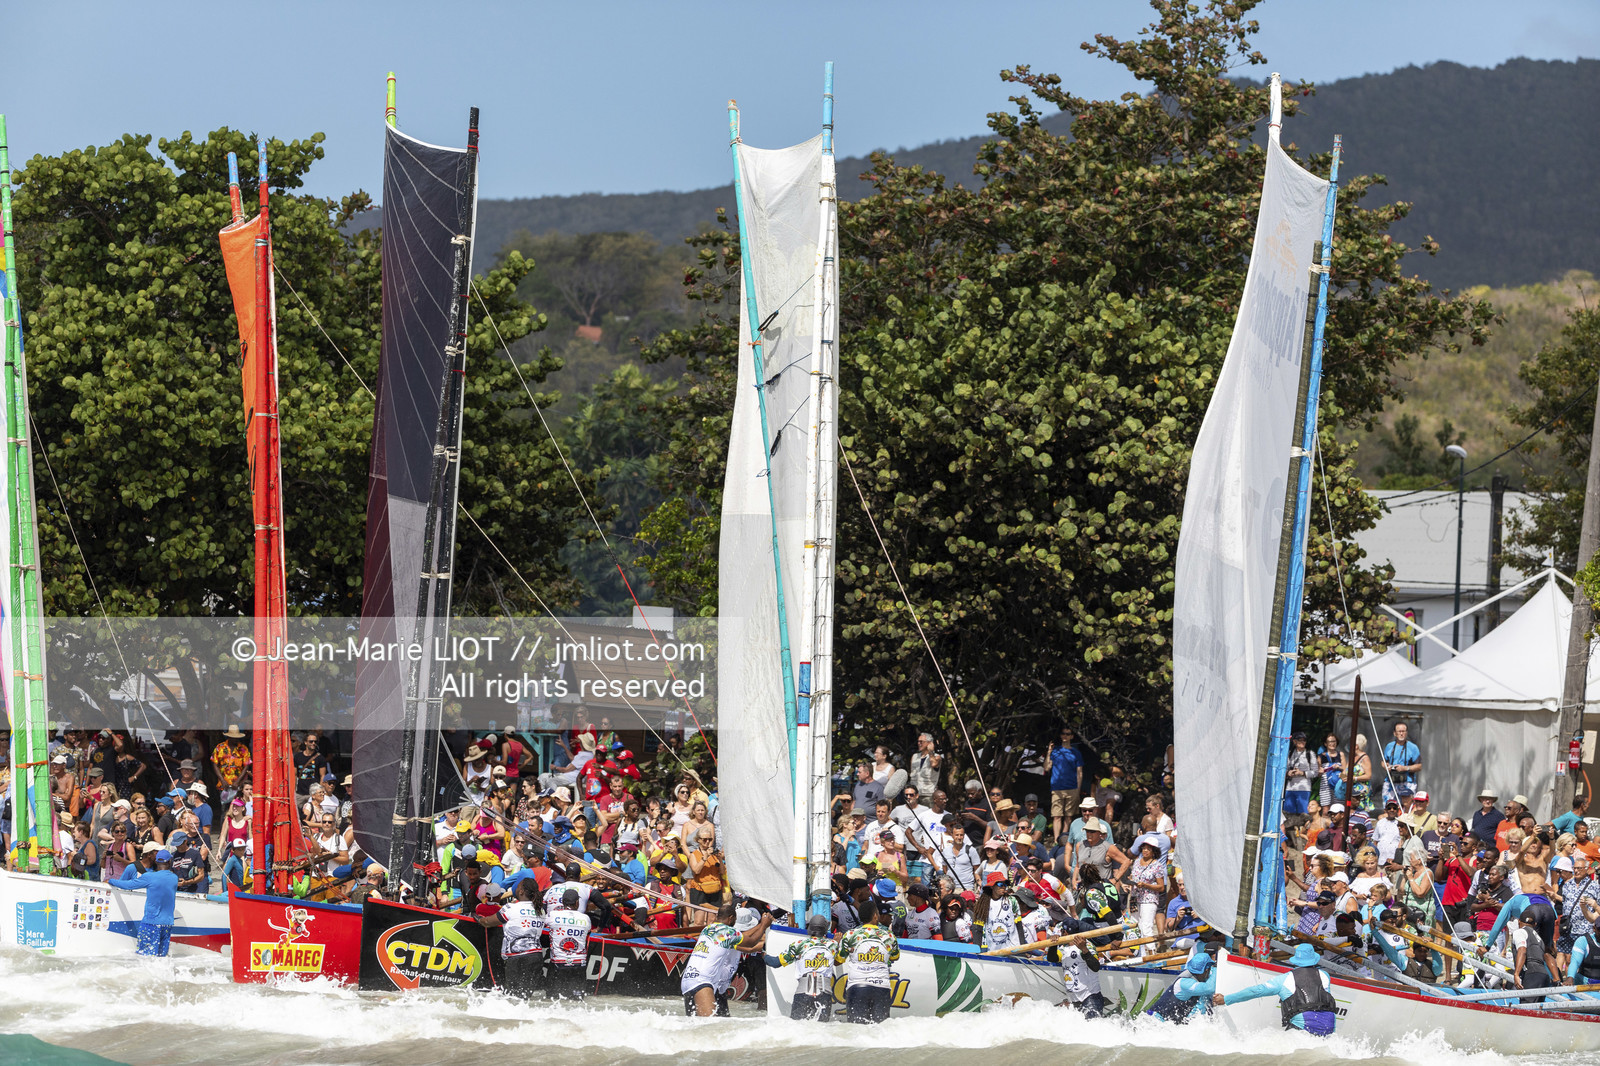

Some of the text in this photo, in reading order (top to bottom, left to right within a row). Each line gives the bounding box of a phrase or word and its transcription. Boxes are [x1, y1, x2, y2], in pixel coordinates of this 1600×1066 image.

[26, 930, 44, 938] Mare
[26, 938, 54, 947] Gaillard
[253, 948, 321, 967] SOMAREC
[386, 940, 476, 976] CTDM
[805, 957, 830, 971] ROYAL
[858, 951, 885, 964] ROYAL
[390, 966, 462, 984] Rachat de métaux
